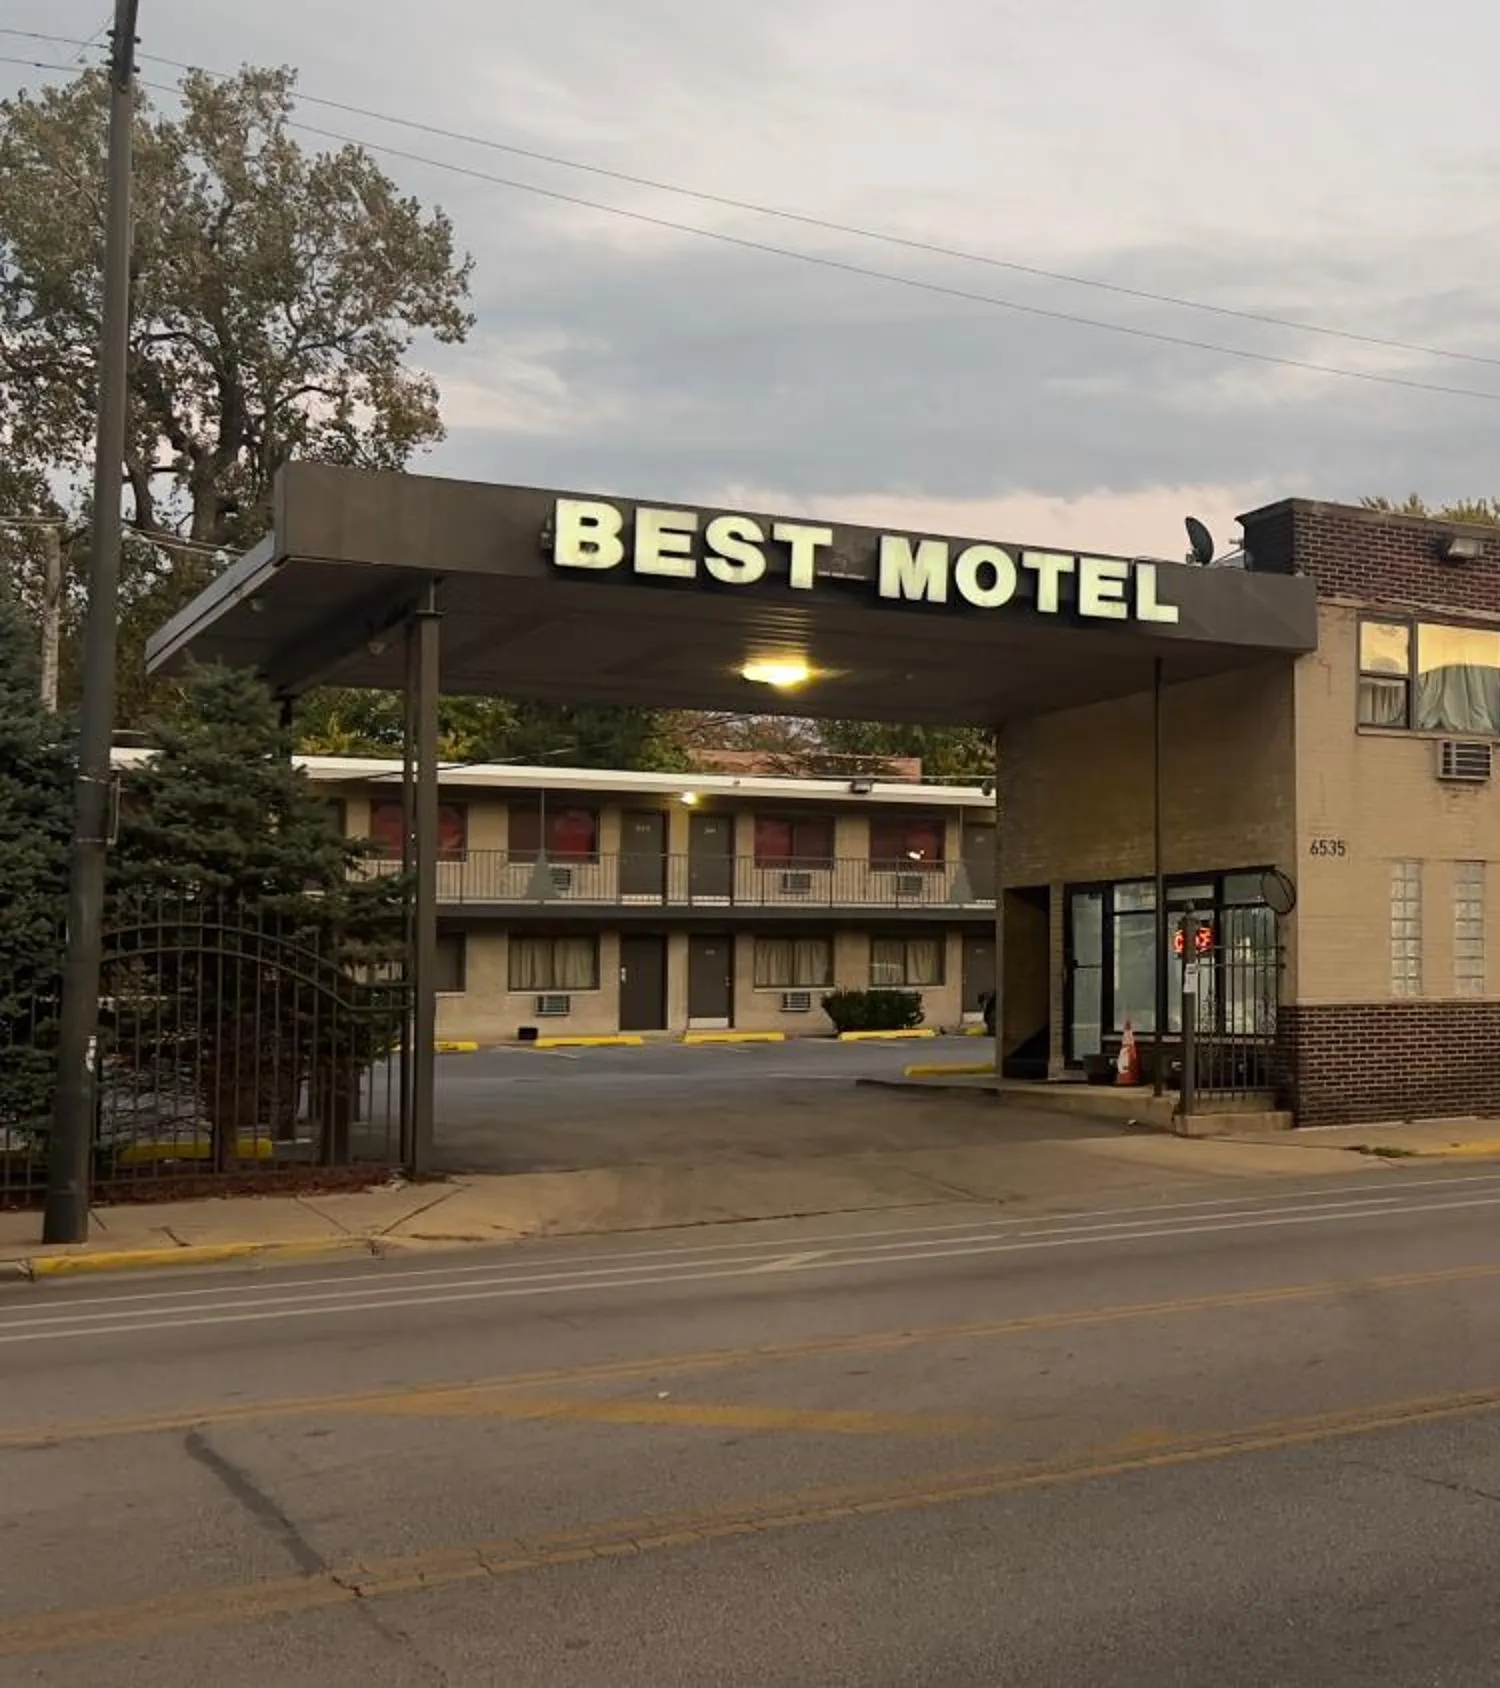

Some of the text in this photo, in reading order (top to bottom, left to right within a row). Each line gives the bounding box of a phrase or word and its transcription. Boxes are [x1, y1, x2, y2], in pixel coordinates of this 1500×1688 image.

[554, 498, 1180, 624] BEST MOTEL
[1310, 838, 1346, 857] 6535
